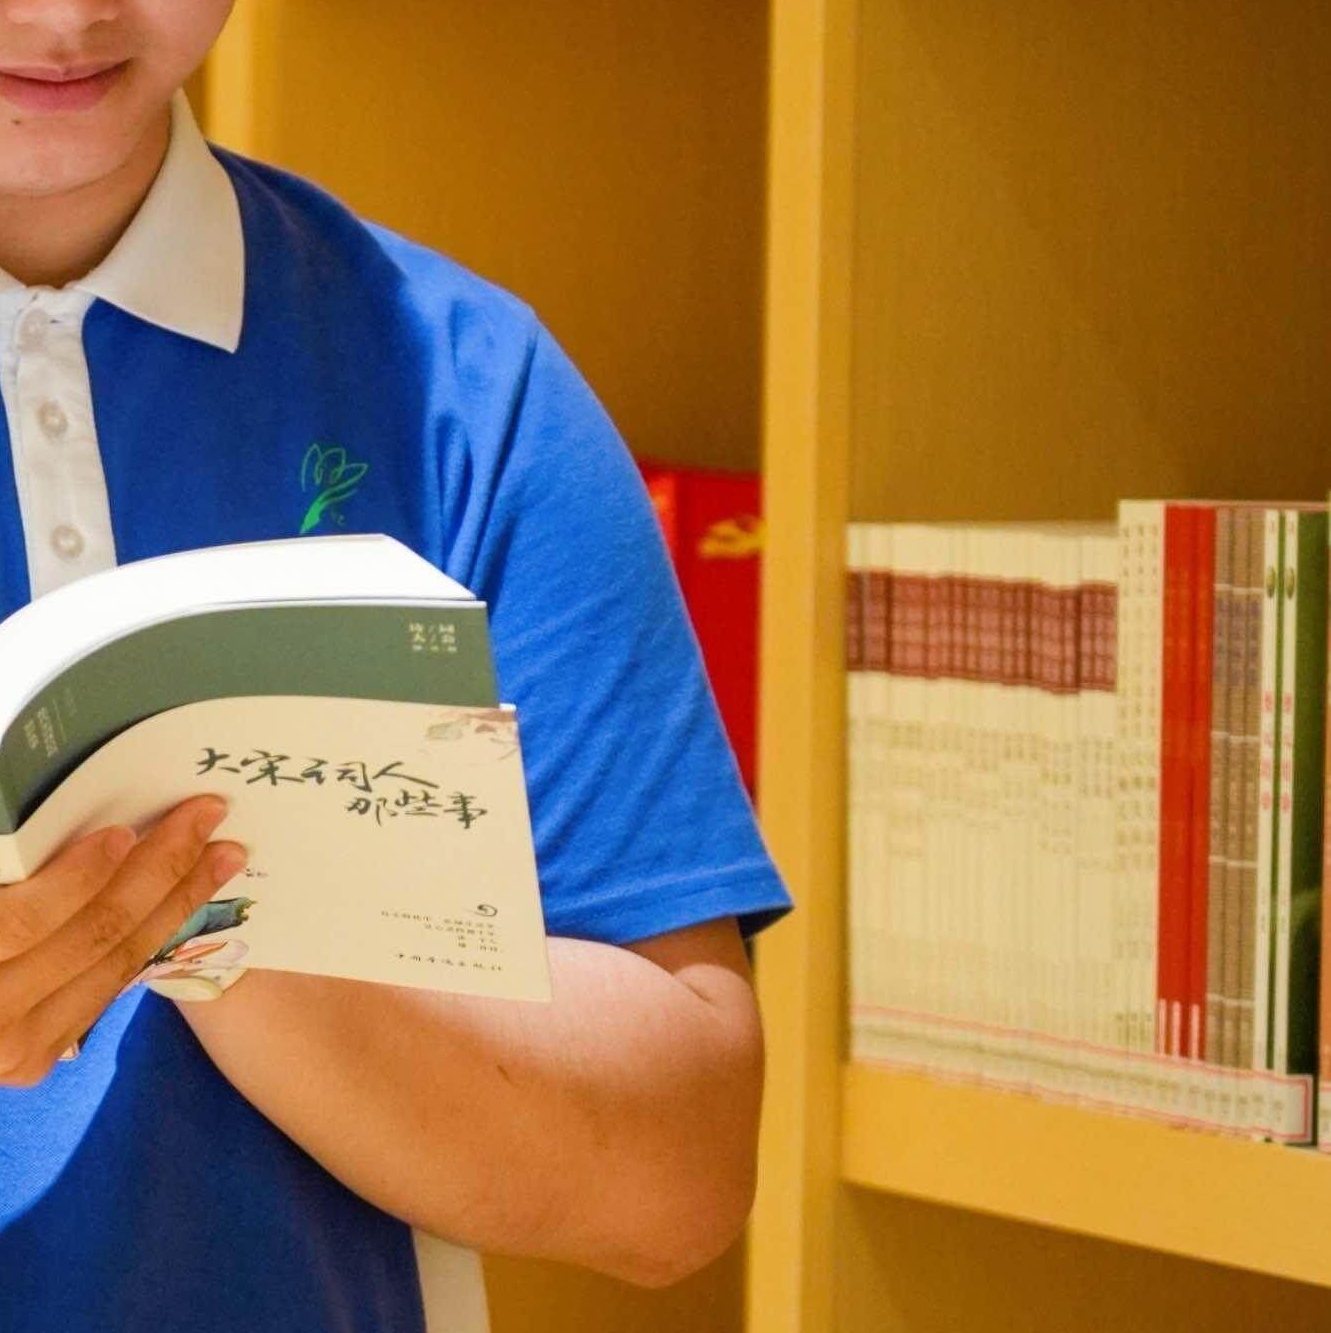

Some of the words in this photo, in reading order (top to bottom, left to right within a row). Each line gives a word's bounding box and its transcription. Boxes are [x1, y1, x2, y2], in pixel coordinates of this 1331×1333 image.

[196, 747, 440, 792] 大宋词人
[346, 788, 488, 829] 那些事
